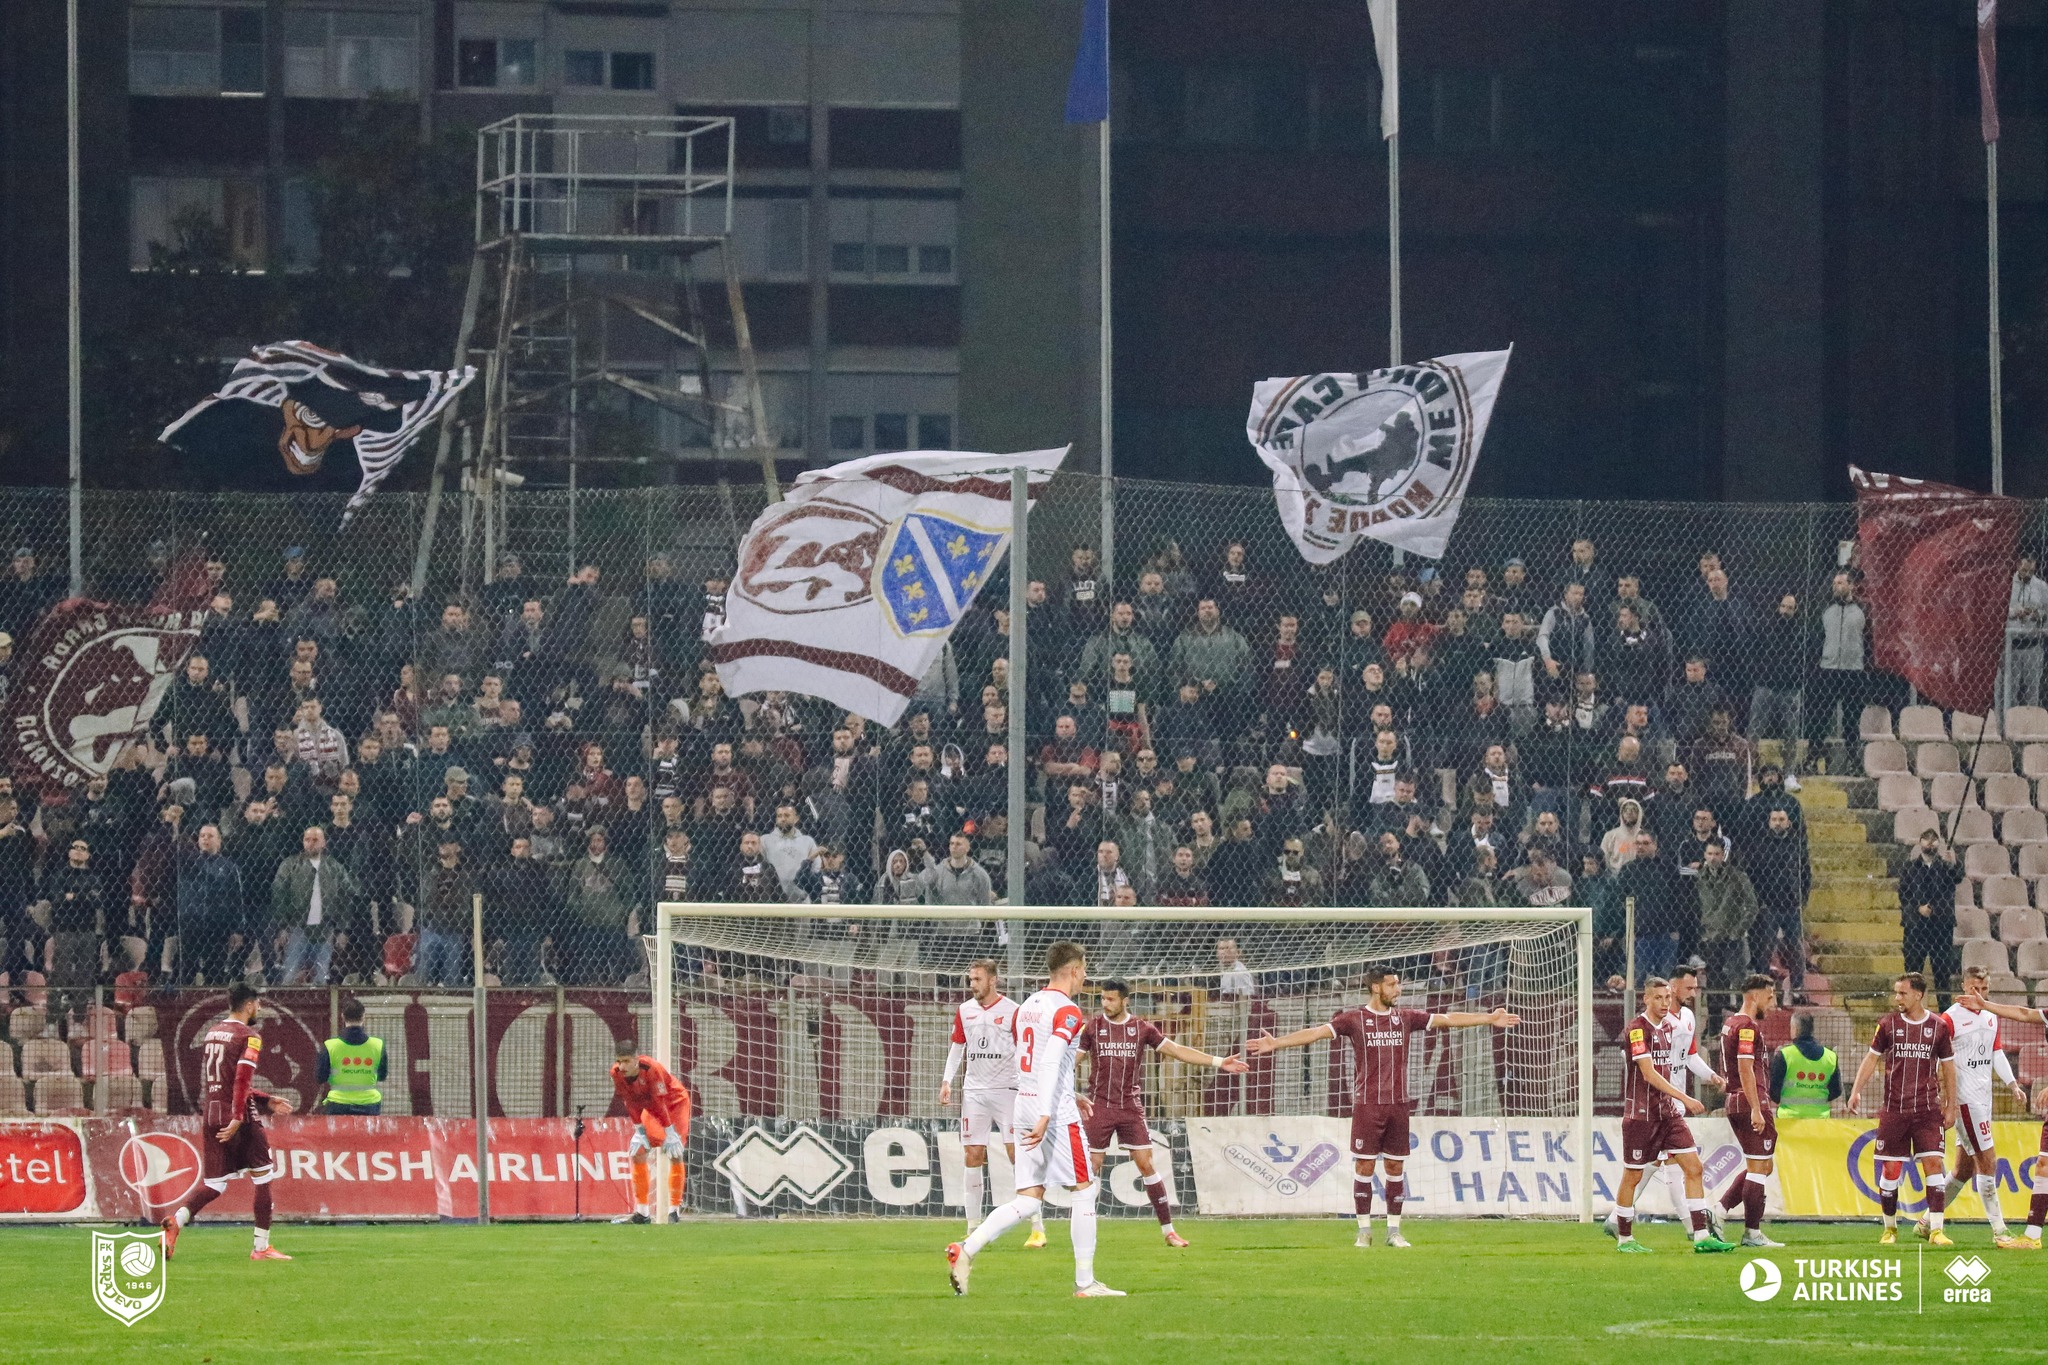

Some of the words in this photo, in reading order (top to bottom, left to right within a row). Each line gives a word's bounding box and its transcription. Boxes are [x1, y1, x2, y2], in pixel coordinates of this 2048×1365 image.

[1099, 1042, 1137, 1051] TURKISH
[1366, 1032, 1403, 1040] TURKISH
[1366, 1038, 1403, 1047] AIRLINES
[1895, 1043, 1931, 1051] TURKISH
[1020, 1026, 1034, 1072] 3
[1099, 1049, 1137, 1058] AIRLINES
[1895, 1050, 1931, 1059] AIRLINES
[205, 1043, 224, 1082] 27
[0, 1150, 66, 1184] tel
[238, 1150, 434, 1182] URKISH
[449, 1150, 633, 1183] AIRLINE
[1228, 1147, 1274, 1182] apoteka
[1306, 1149, 1333, 1171] hana
[1710, 1150, 1736, 1174] hana
